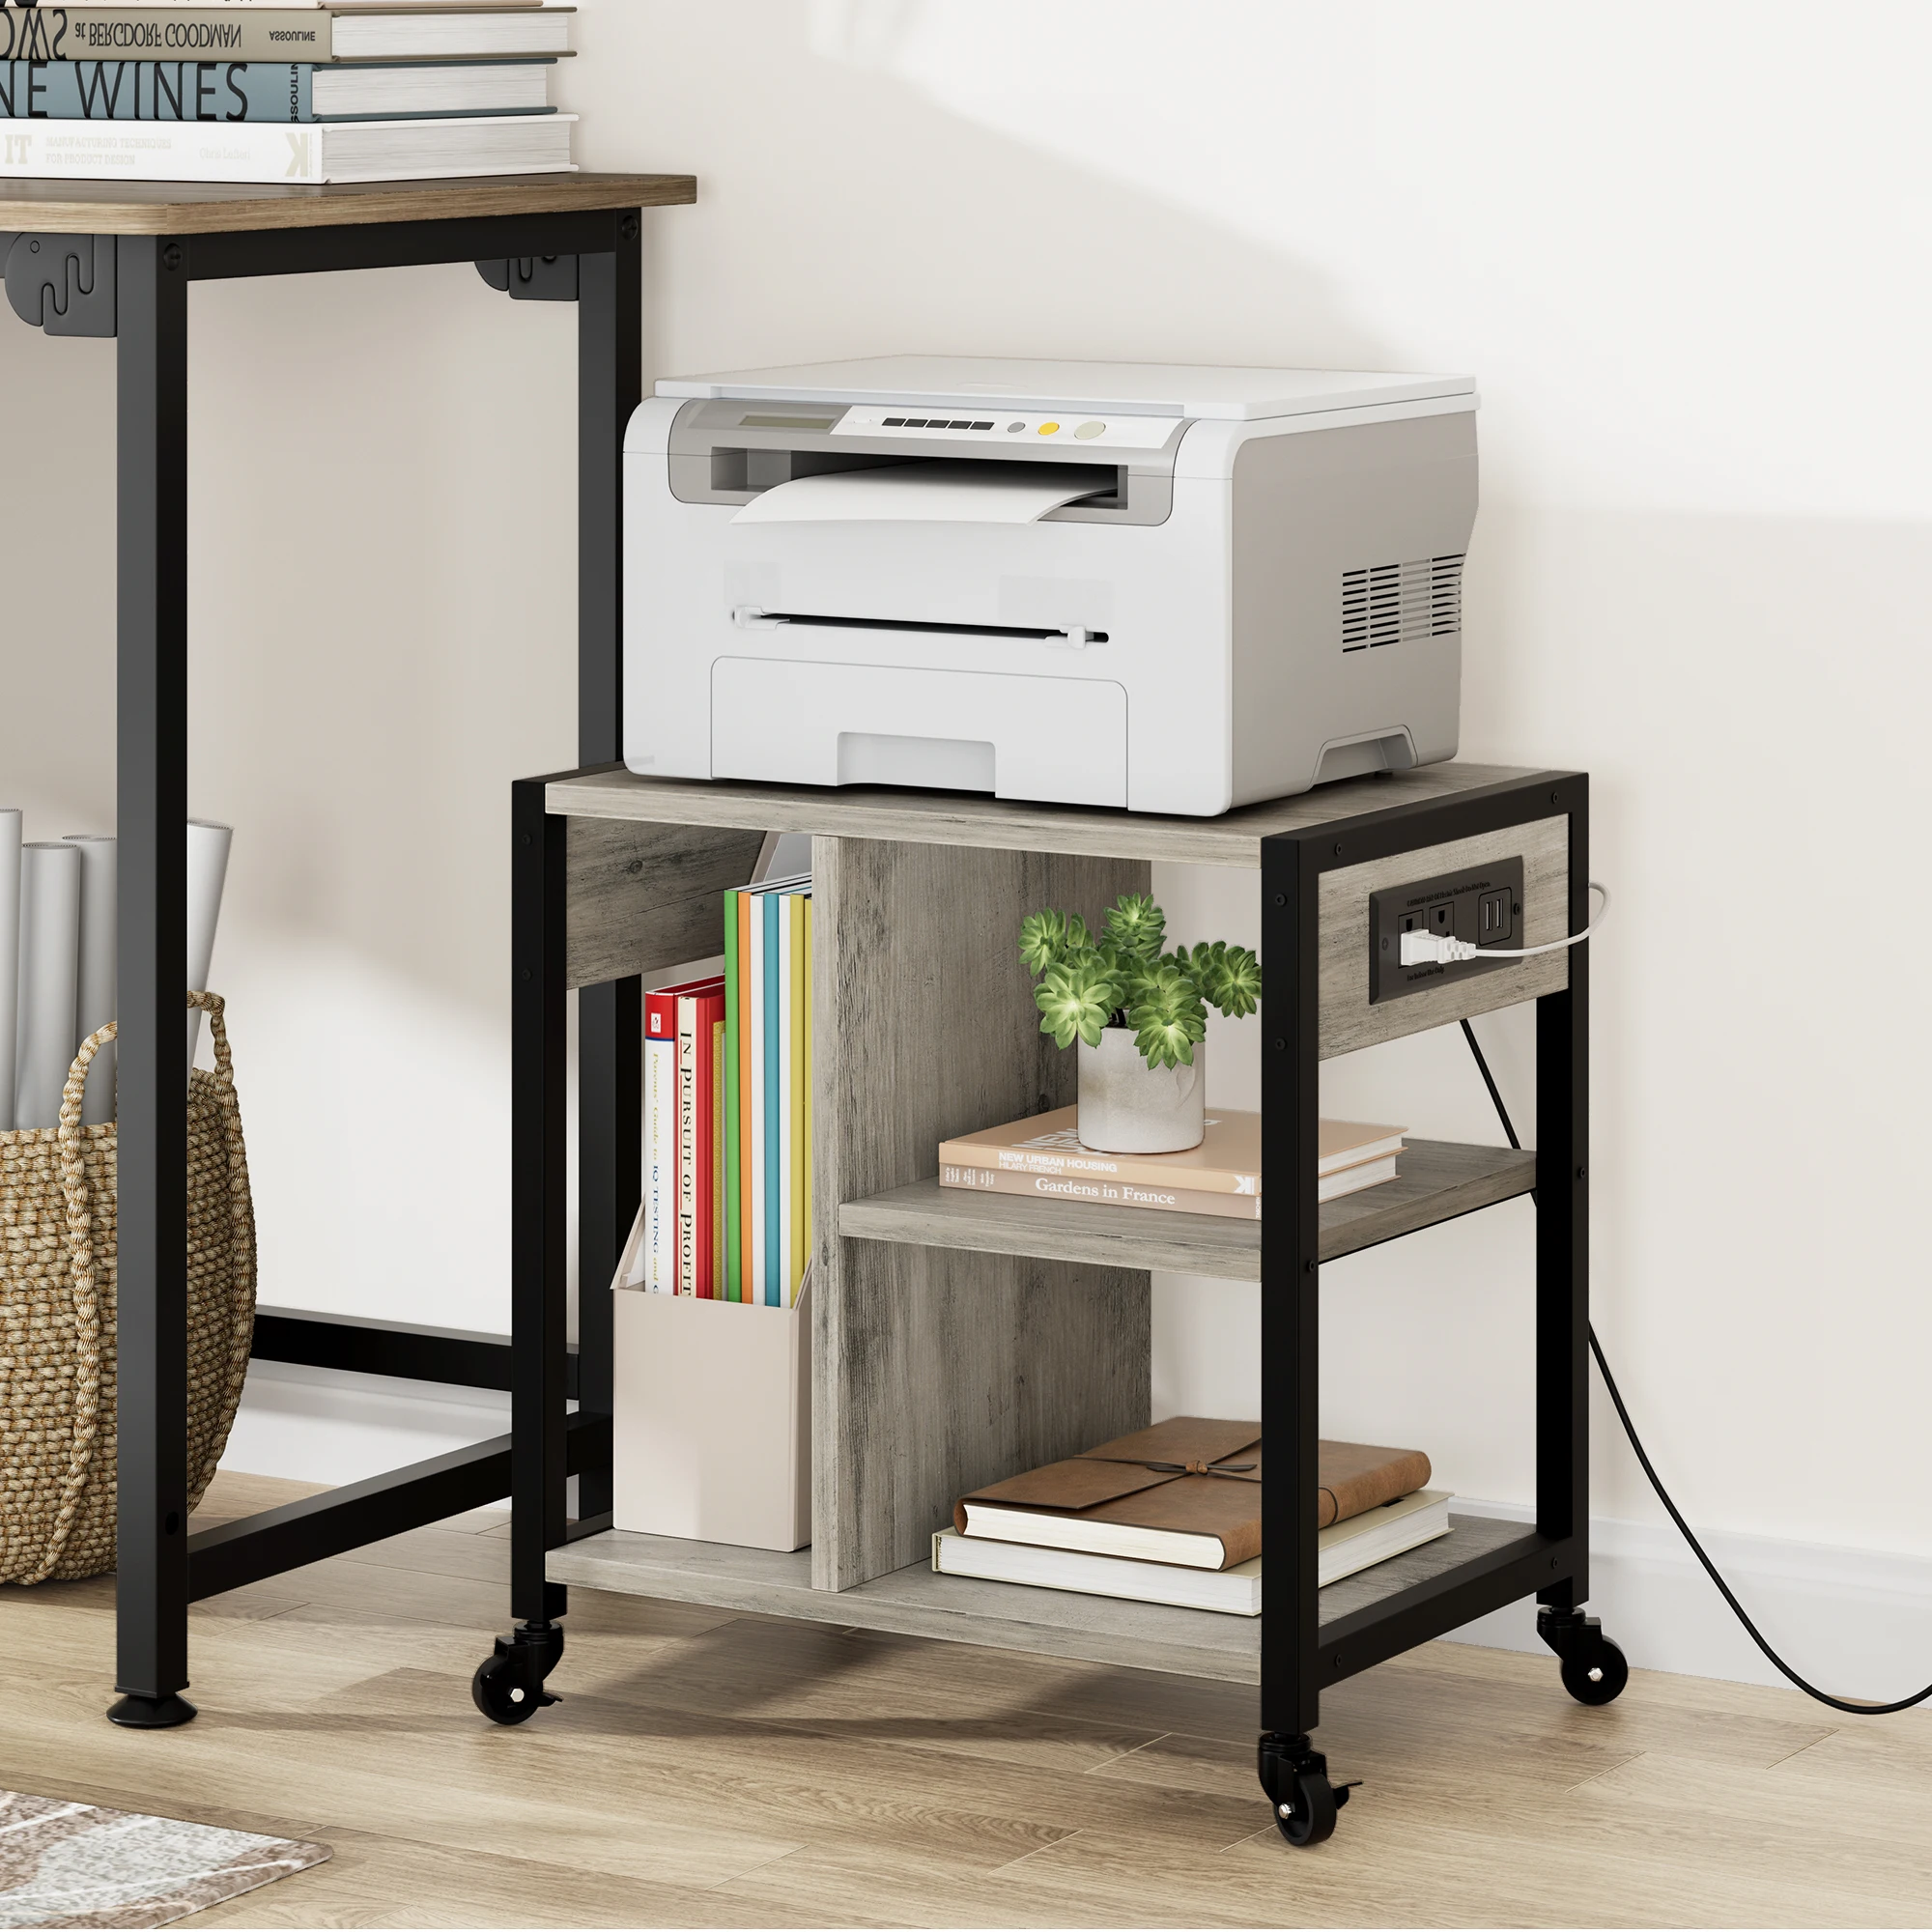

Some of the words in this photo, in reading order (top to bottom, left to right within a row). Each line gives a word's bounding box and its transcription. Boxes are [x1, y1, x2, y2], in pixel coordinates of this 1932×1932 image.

[74, 61, 248, 122] WINES
[5, 134, 32, 164] IT
[45, 136, 118, 149] MANUFACTURING
[119, 137, 172, 150] TECHNIQUES
[45, 154, 63, 164] FOR
[64, 154, 103, 165] PRODUCT
[104, 155, 135, 166] DESIGN
[998, 1151, 1024, 1163] NEW
[1026, 1153, 1065, 1168] URBAN
[1066, 1157, 1118, 1173] HOUSING
[999, 1161, 1028, 1172] HILARY
[1029, 1163, 1063, 1175] FRENCH
[652, 1165, 659, 1182] IQ
[1035, 1177, 1099, 1197] Gardens
[1103, 1183, 1119, 1199] in
[1122, 1186, 1176, 1205] France
